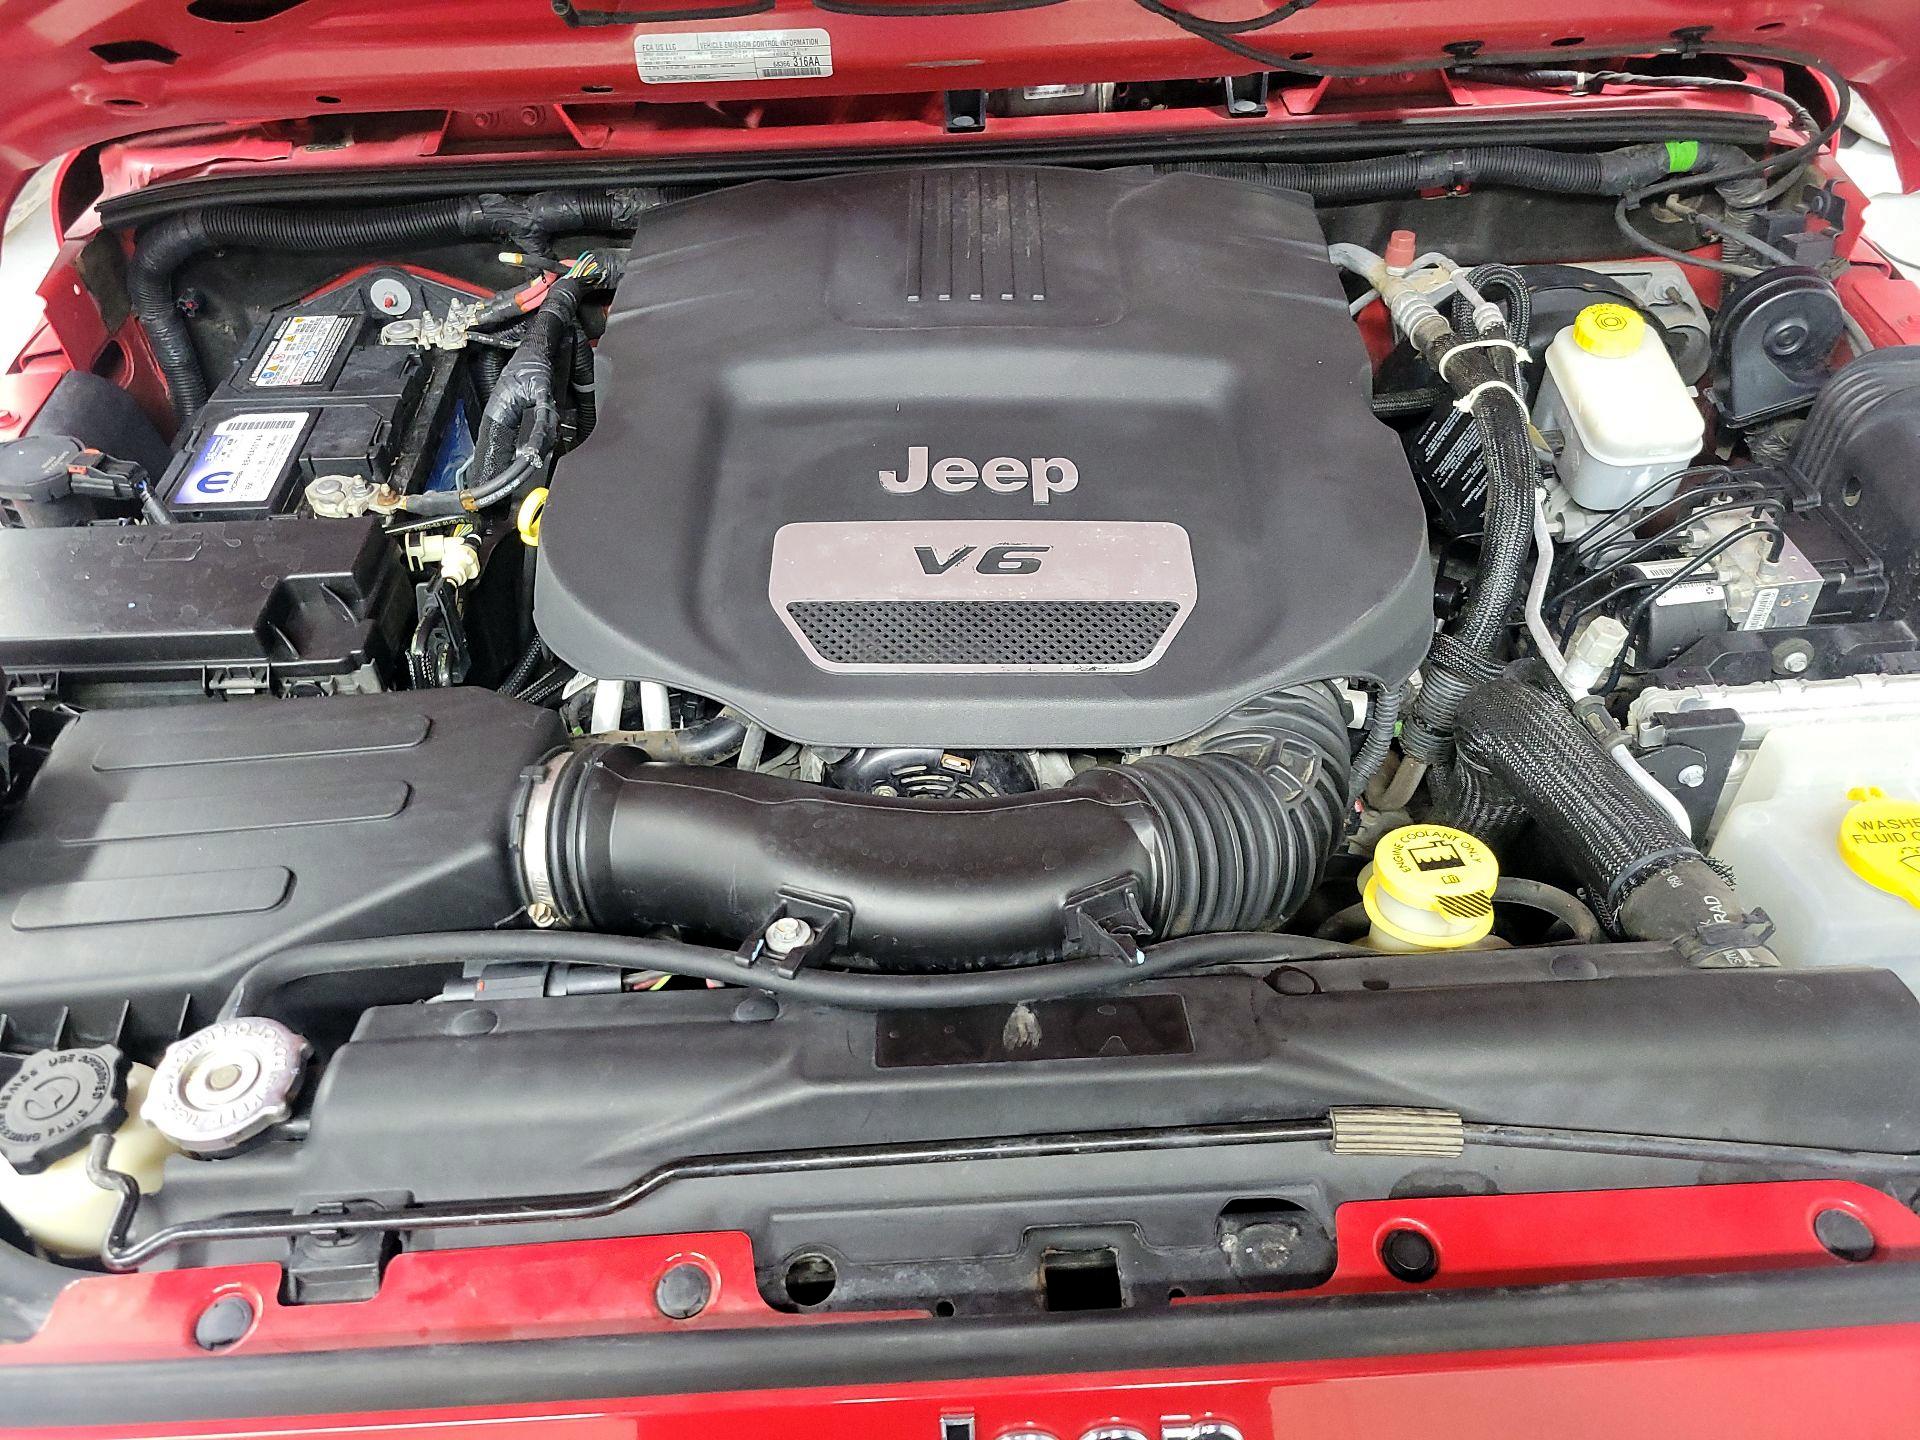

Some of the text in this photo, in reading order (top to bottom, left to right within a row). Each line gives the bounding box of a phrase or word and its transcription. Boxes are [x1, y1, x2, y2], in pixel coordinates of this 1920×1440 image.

[700, 38, 819, 50] VEHICLE EMISSION CONTROL INFORMATION
[793, 56, 821, 67] 316AA
[878, 446, 1080, 506] Jeep
[913, 544, 1052, 575] V6
[1391, 831, 1483, 874] ENGINE COOLANT ONLY
[1852, 832, 1906, 844] FLUID
[1703, 895, 1731, 924] RAD
